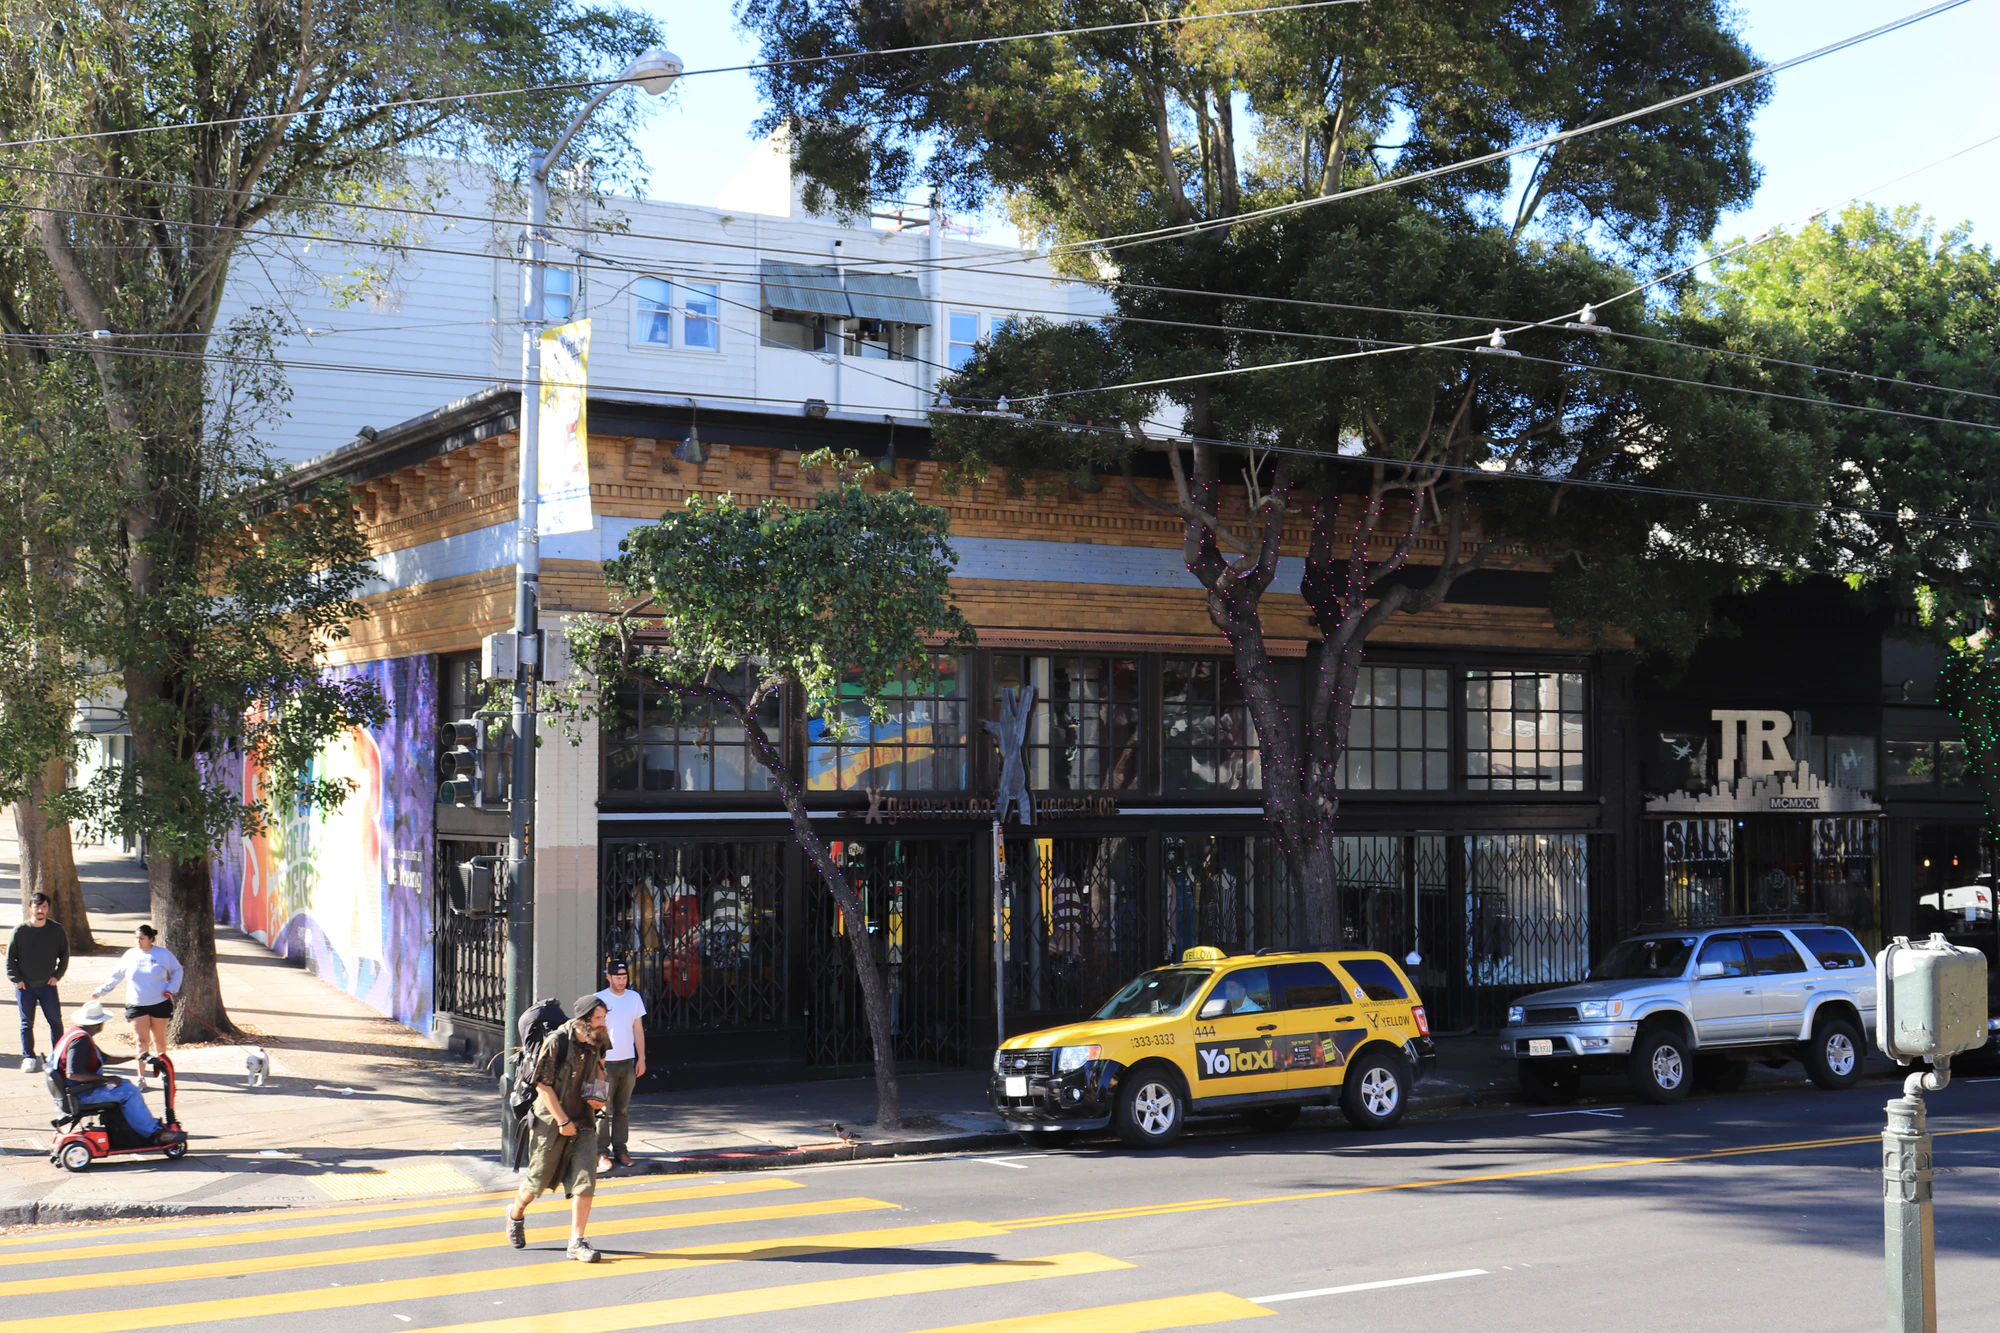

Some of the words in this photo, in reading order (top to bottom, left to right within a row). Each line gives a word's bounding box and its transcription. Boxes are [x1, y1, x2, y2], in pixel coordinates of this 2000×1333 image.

[1711, 709, 1796, 774] TR
[1666, 820, 1729, 861] SALE
[398, 864, 422, 894] Young
[1185, 950, 1212, 960] YELLOW
[1195, 1025, 1216, 1037] 444
[1381, 1015, 1410, 1027] YELLOW
[1133, 1033, 1175, 1048] 333-3333
[1199, 1047, 1274, 1075] YoTaxi
